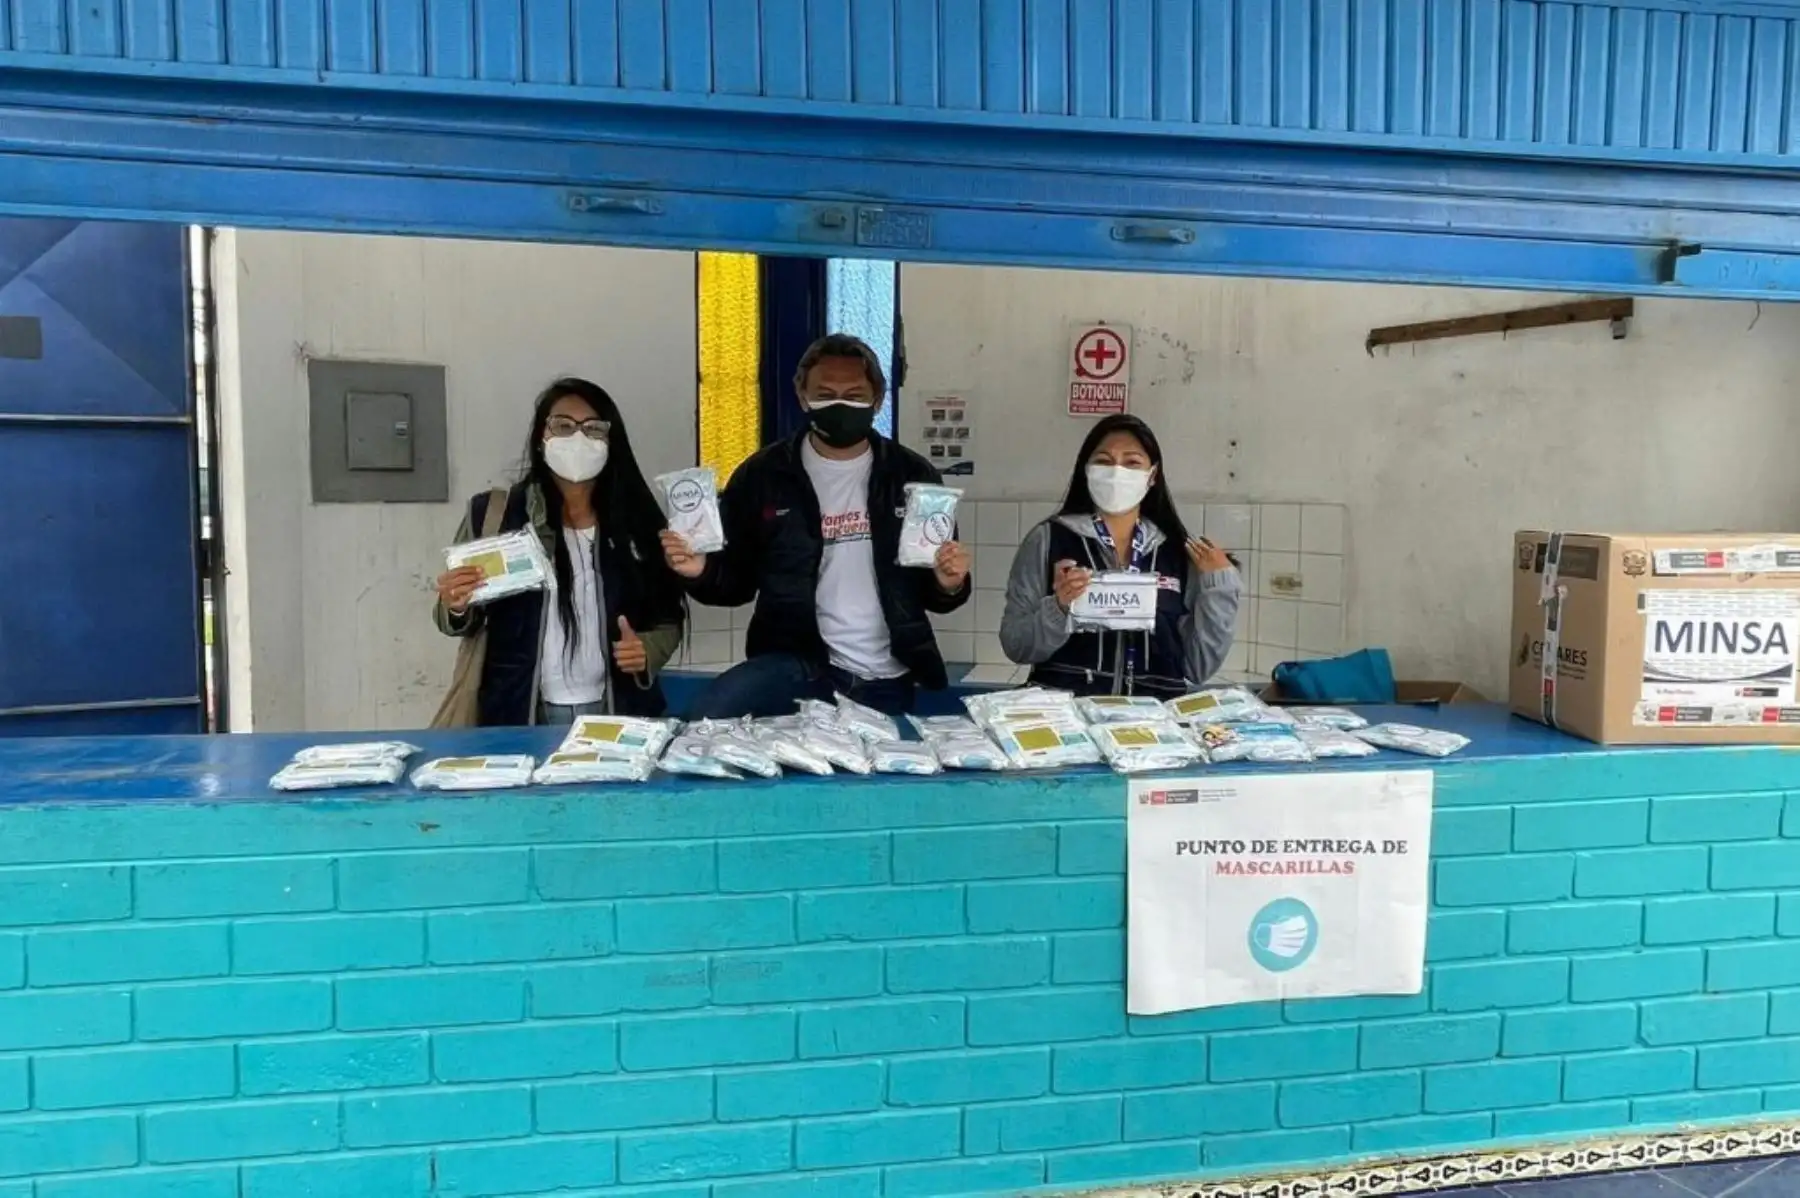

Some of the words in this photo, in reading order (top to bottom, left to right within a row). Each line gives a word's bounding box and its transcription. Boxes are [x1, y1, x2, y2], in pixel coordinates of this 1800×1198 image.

[1072, 383, 1125, 400] BOTIQUIN
[1088, 591, 1141, 606] MINSA
[1654, 619, 1789, 655] MINSA
[1176, 840, 1246, 855] PUNTO
[1250, 840, 1278, 854] DE
[1283, 839, 1377, 854] ENTREGA
[1383, 840, 1408, 854] DE
[1215, 860, 1355, 876] MASCARILLAS
